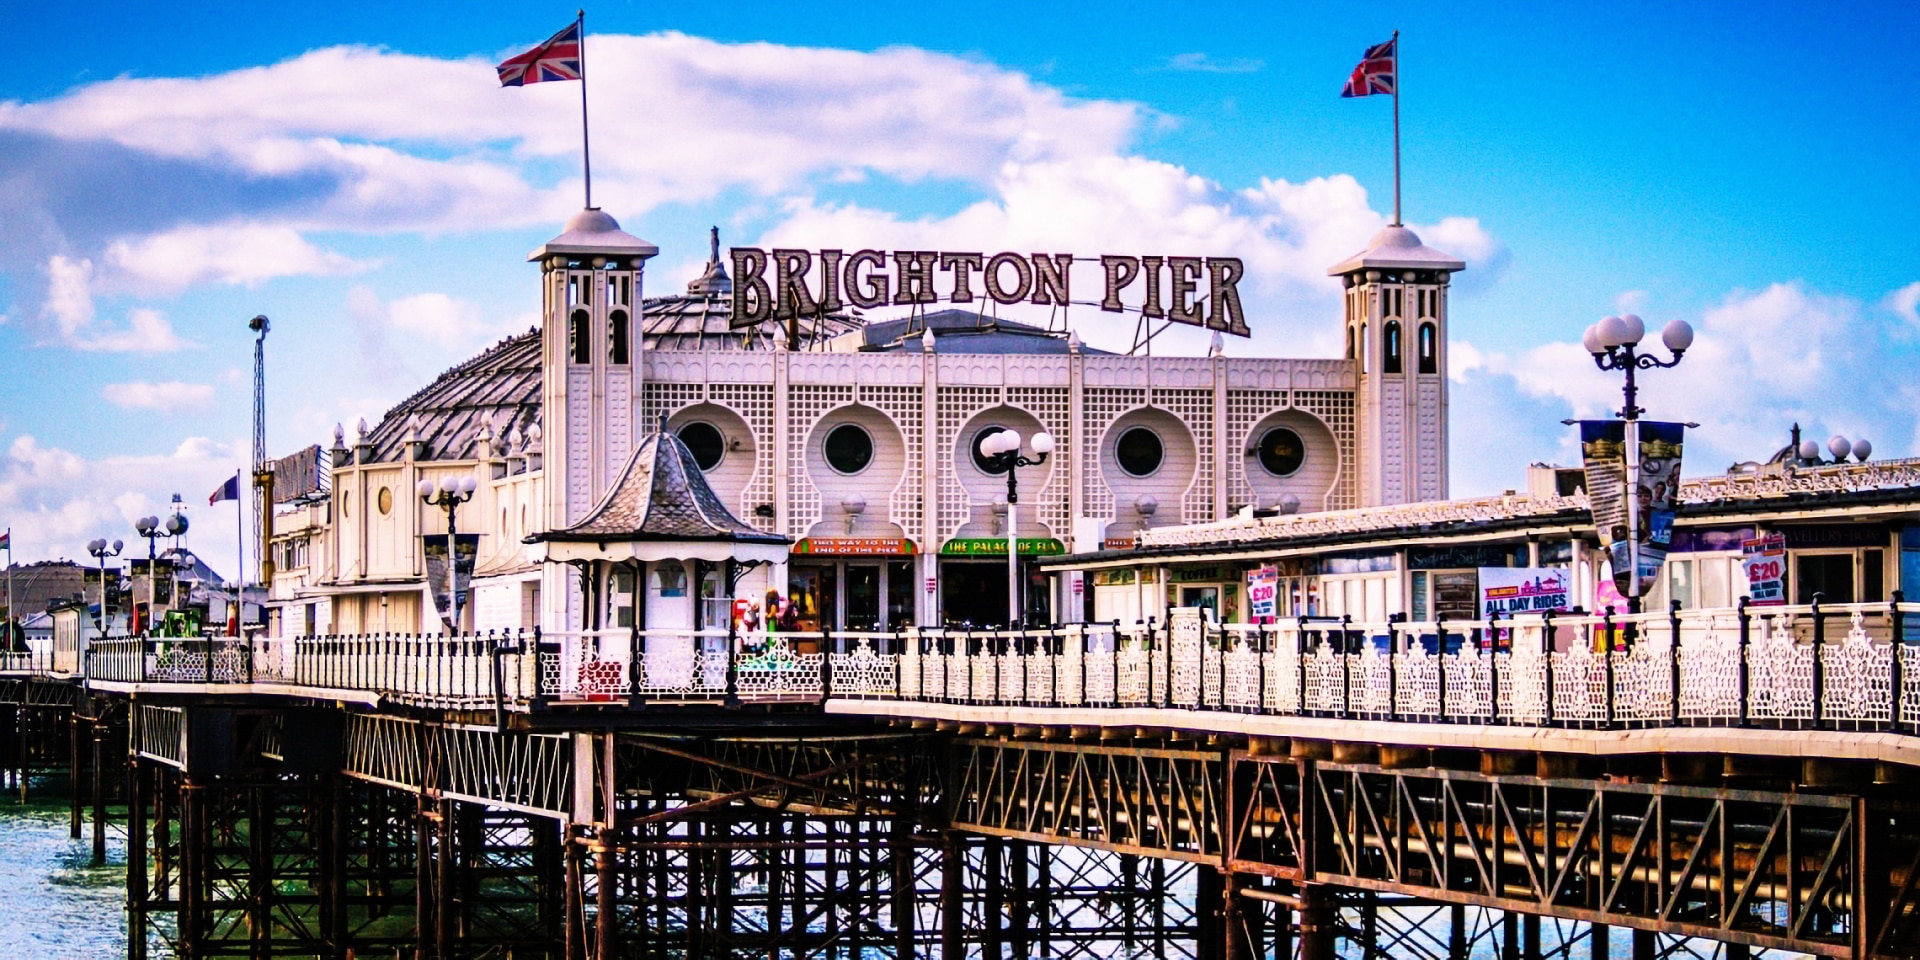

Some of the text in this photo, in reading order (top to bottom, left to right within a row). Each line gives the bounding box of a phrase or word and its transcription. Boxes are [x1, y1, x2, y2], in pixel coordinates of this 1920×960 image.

[729, 247, 1251, 338] BRIGHTON PIER
[1786, 529, 1842, 542] WELLERY
[949, 542, 967, 552] THE
[1018, 542, 1031, 552] OF
[1036, 542, 1057, 553] FUN
[1750, 561, 1779, 582] £20
[1253, 586, 1273, 601] £20
[1485, 594, 1567, 613] ALL DAY RIDES
